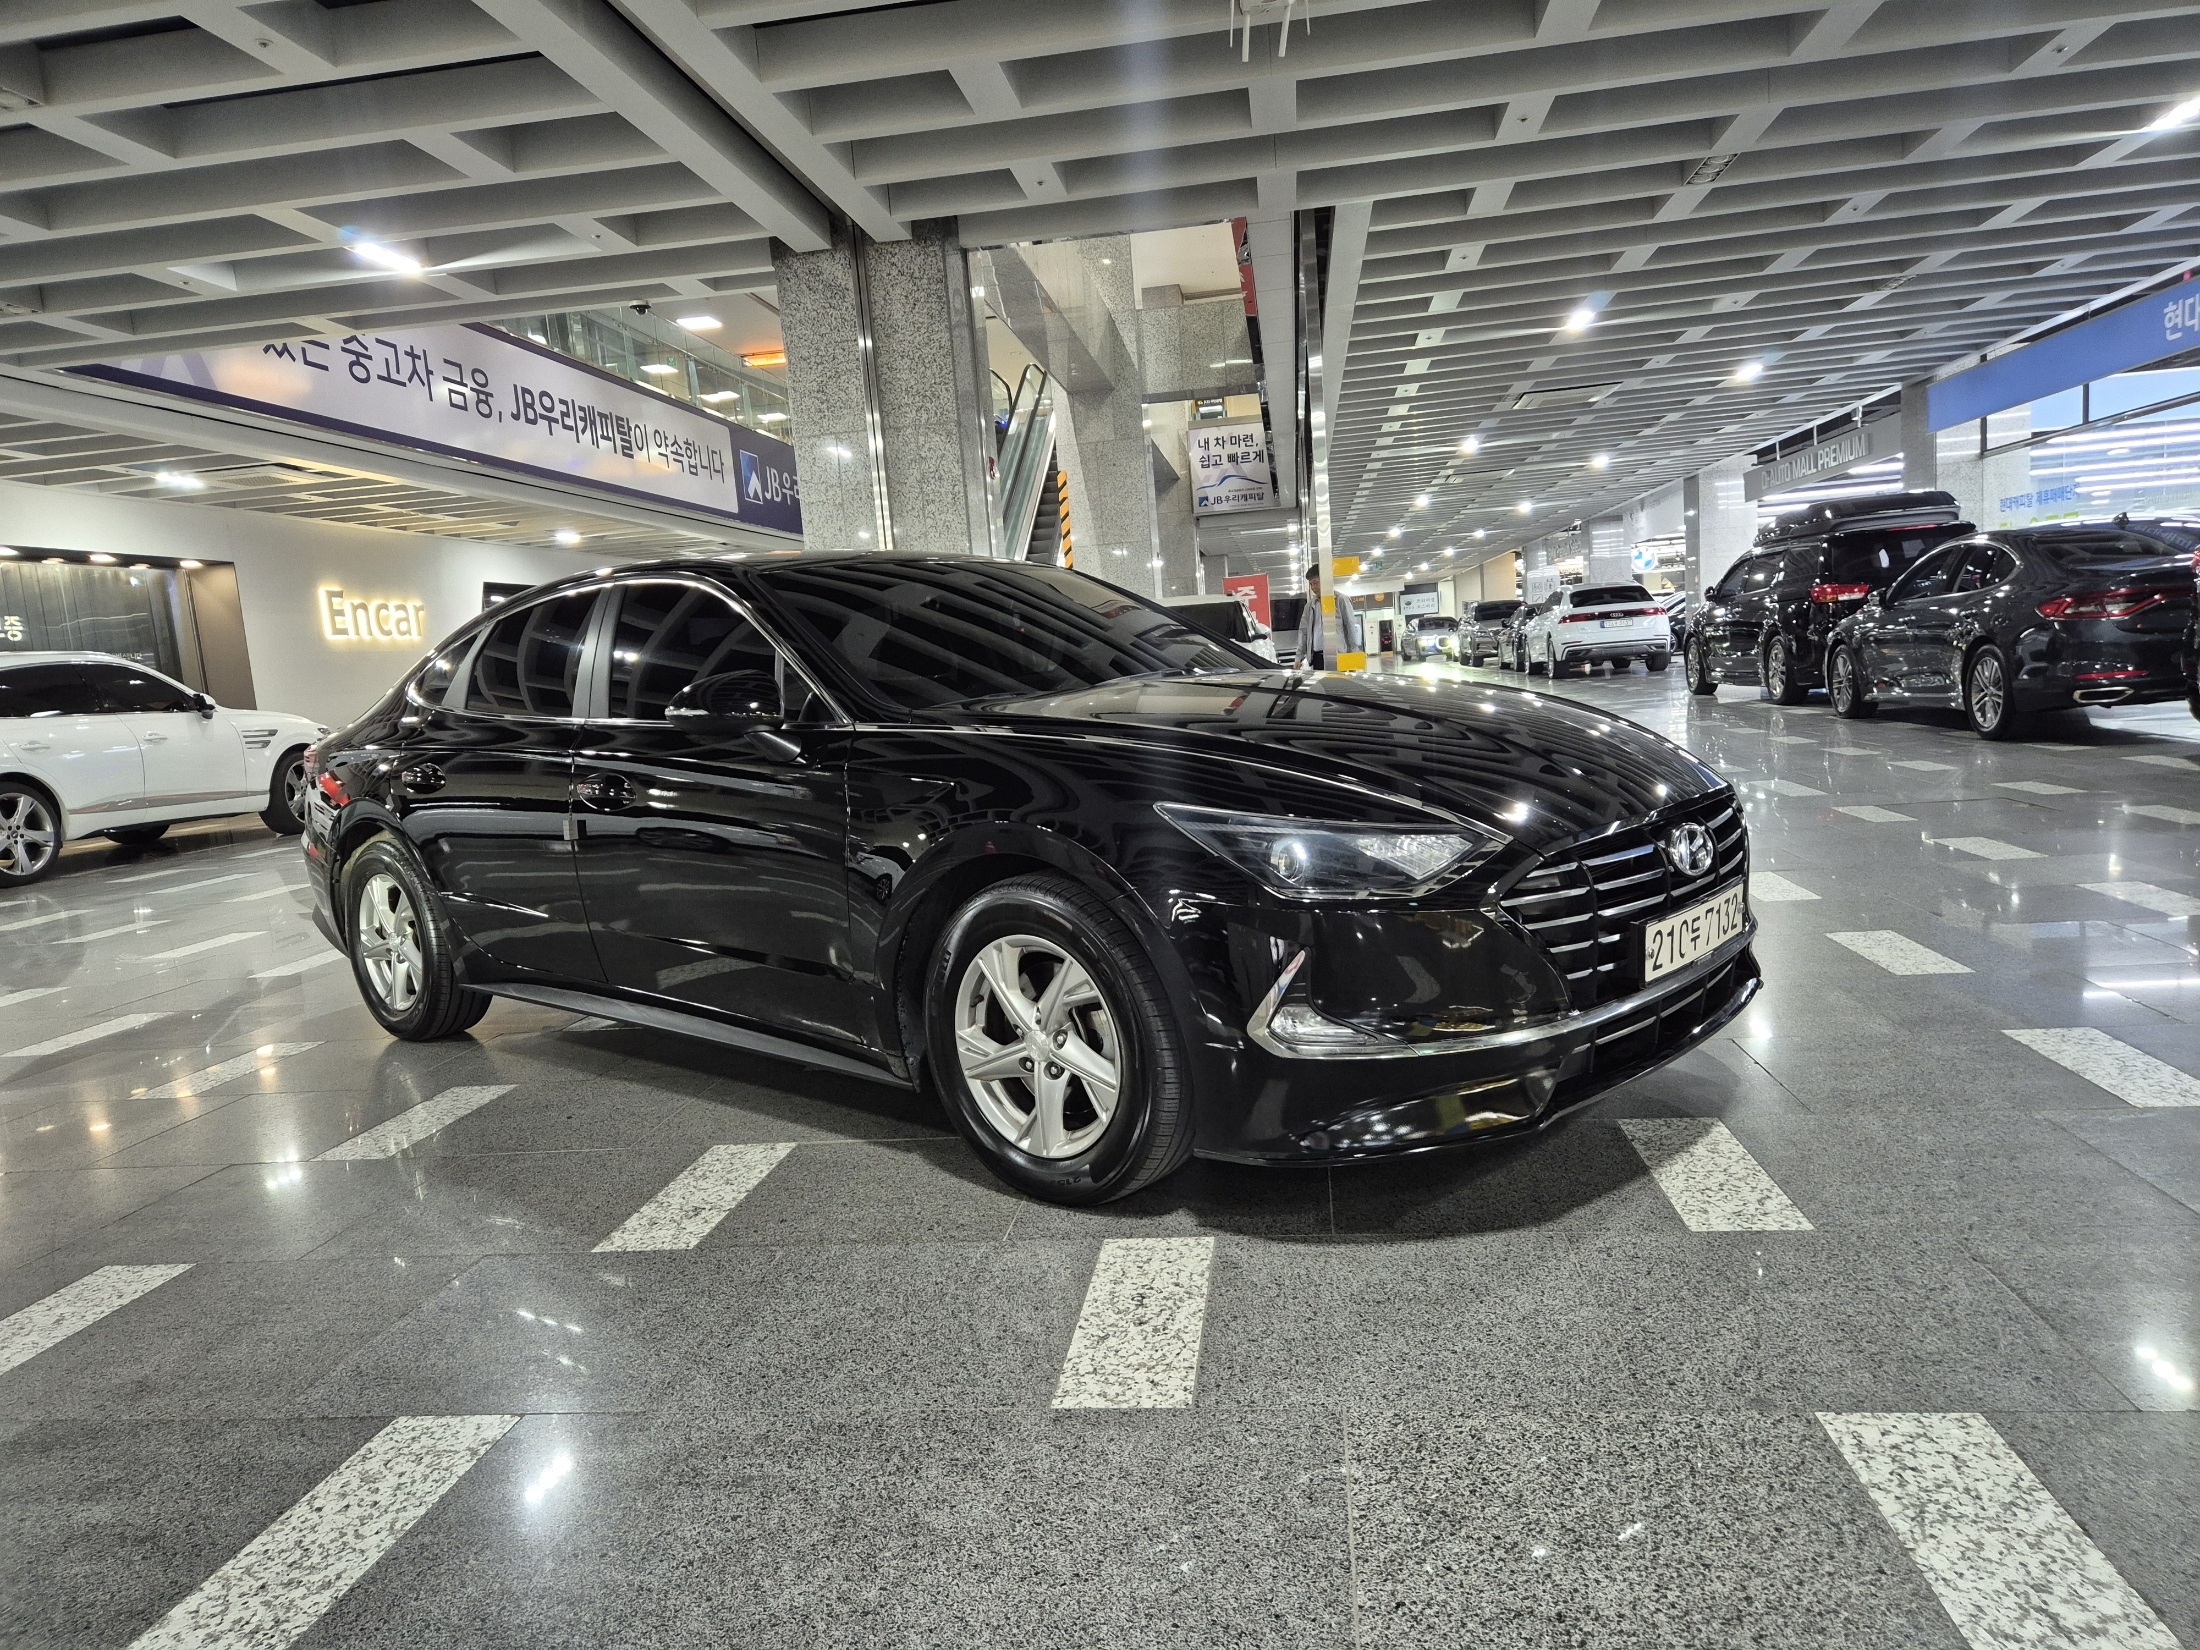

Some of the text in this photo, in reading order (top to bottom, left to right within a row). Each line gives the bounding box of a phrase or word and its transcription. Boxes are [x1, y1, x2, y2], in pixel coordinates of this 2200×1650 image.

[442, 358, 502, 423] 금융,
[510, 383, 651, 463] JB우리캐피탈이
[653, 428, 725, 484] 약속합니다
[1198, 433, 1259, 451] 내 차 마련,
[1199, 449, 1265, 469] 쉽고 빠르게
[1792, 453, 1817, 480] MALL
[1817, 433, 1866, 471] PREMIUM
[321, 588, 425, 638] Encar
